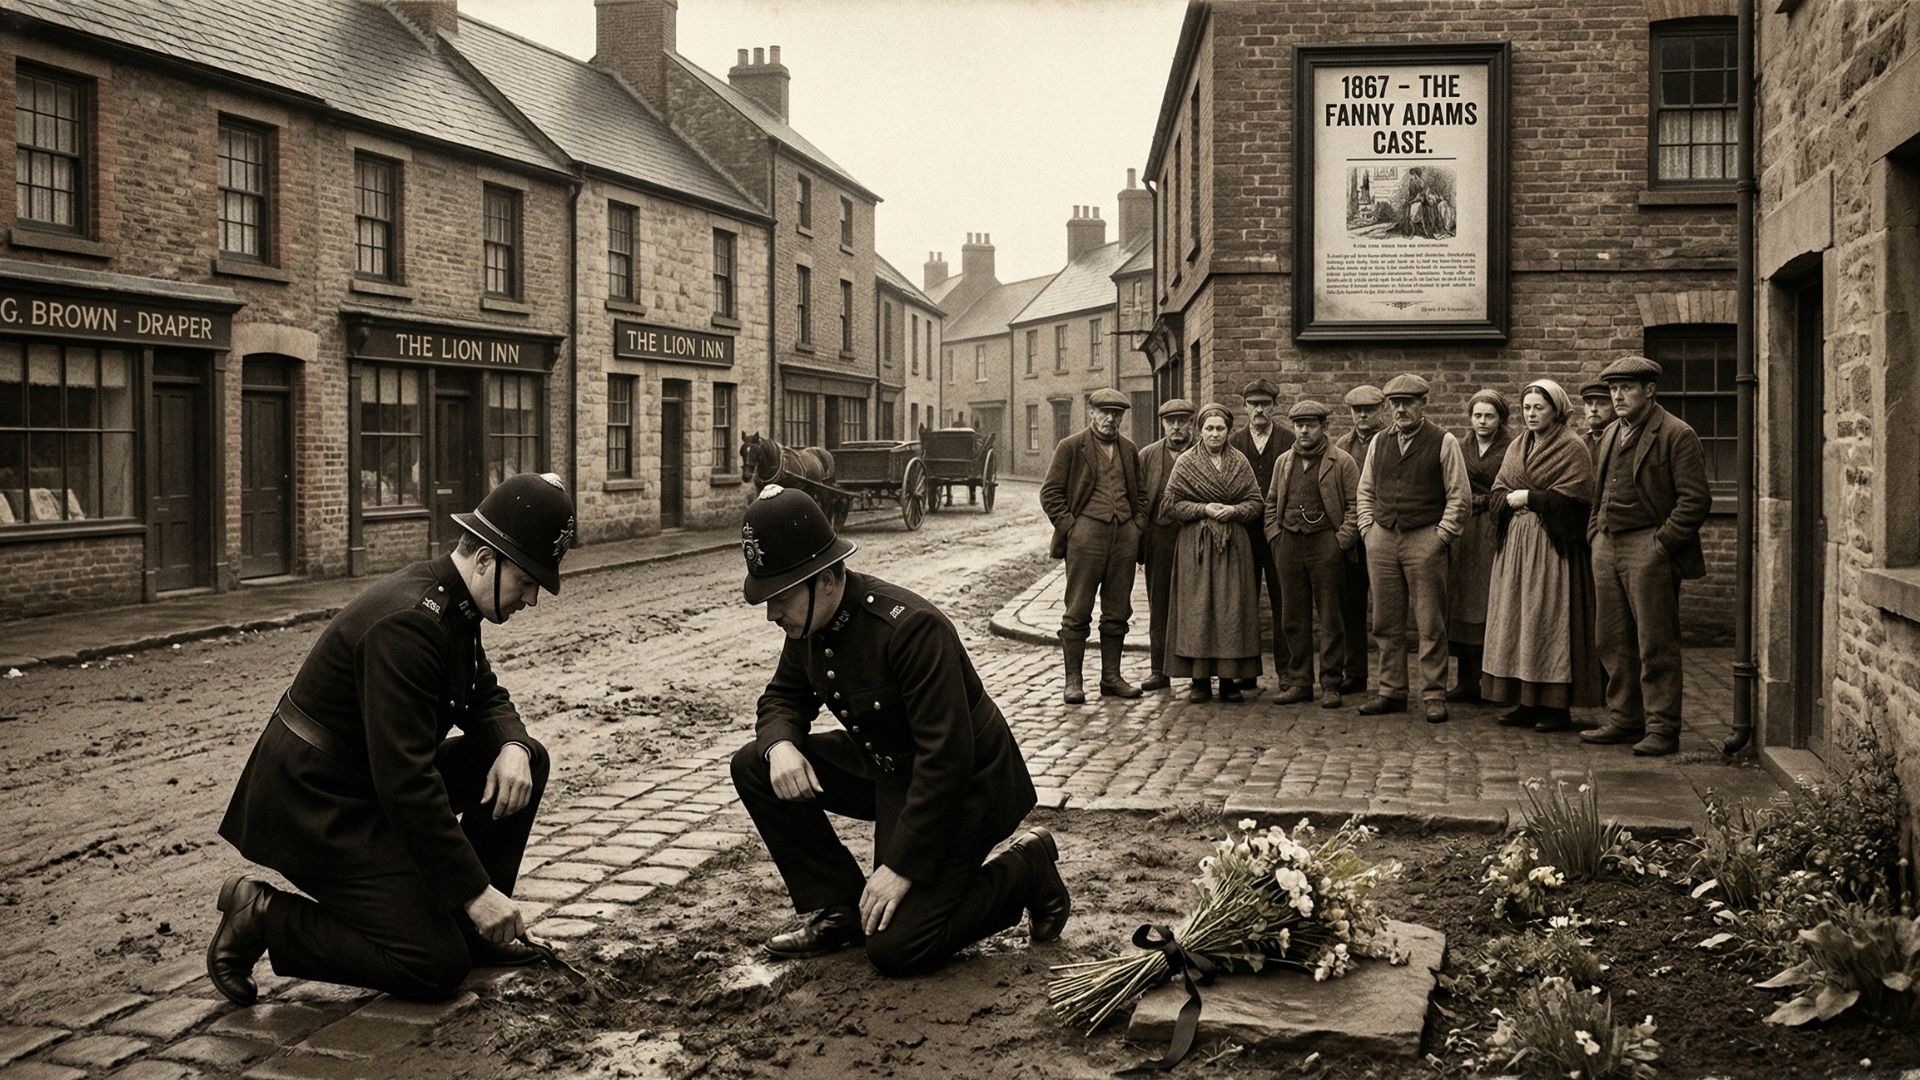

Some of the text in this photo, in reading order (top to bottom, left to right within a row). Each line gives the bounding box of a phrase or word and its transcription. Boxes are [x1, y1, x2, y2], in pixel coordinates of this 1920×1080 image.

[1341, 75, 1390, 99] 1867
[1419, 74, 1461, 98] THE
[1325, 101, 1478, 127] FANNY ADAMS
[1373, 130, 1433, 154] CASE.
[0, 297, 23, 324] G.
[31, 300, 117, 332] BROWN
[137, 311, 213, 340] DRAPER
[396, 333, 520, 364] THE LION INN
[627, 330, 724, 359] THE LION INN
